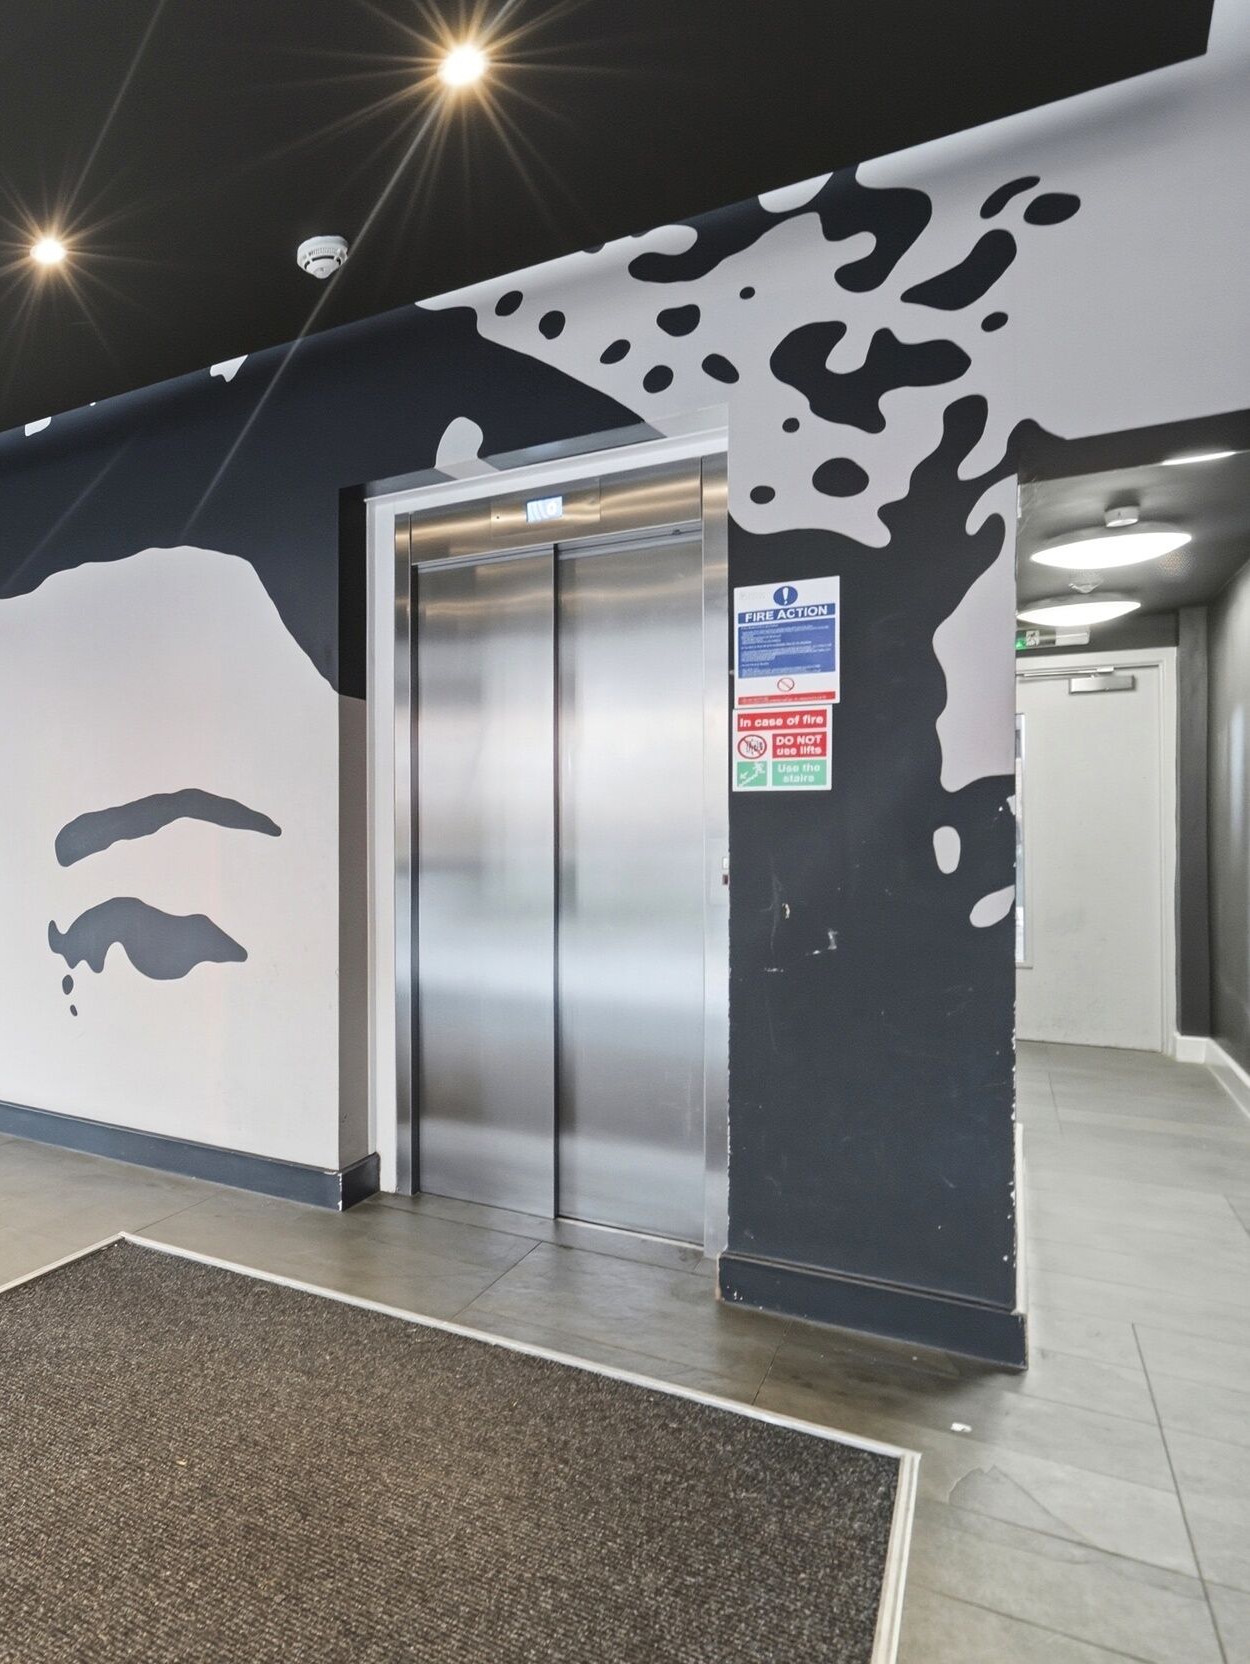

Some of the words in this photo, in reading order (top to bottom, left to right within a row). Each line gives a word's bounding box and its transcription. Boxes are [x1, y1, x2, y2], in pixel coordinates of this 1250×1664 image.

[745, 611, 774, 622] FIRE
[777, 605, 828, 619] ACTION
[739, 718, 752, 727] In
[754, 718, 783, 727] case
[786, 715, 800, 725] of
[802, 715, 824, 724] fire
[776, 736, 794, 746] DO
[797, 735, 822, 744] NOT
[776, 747, 797, 756] use
[800, 745, 822, 754] lifts
[777, 763, 800, 773] Use
[802, 762, 821, 771] the
[782, 773, 815, 783] stairs
